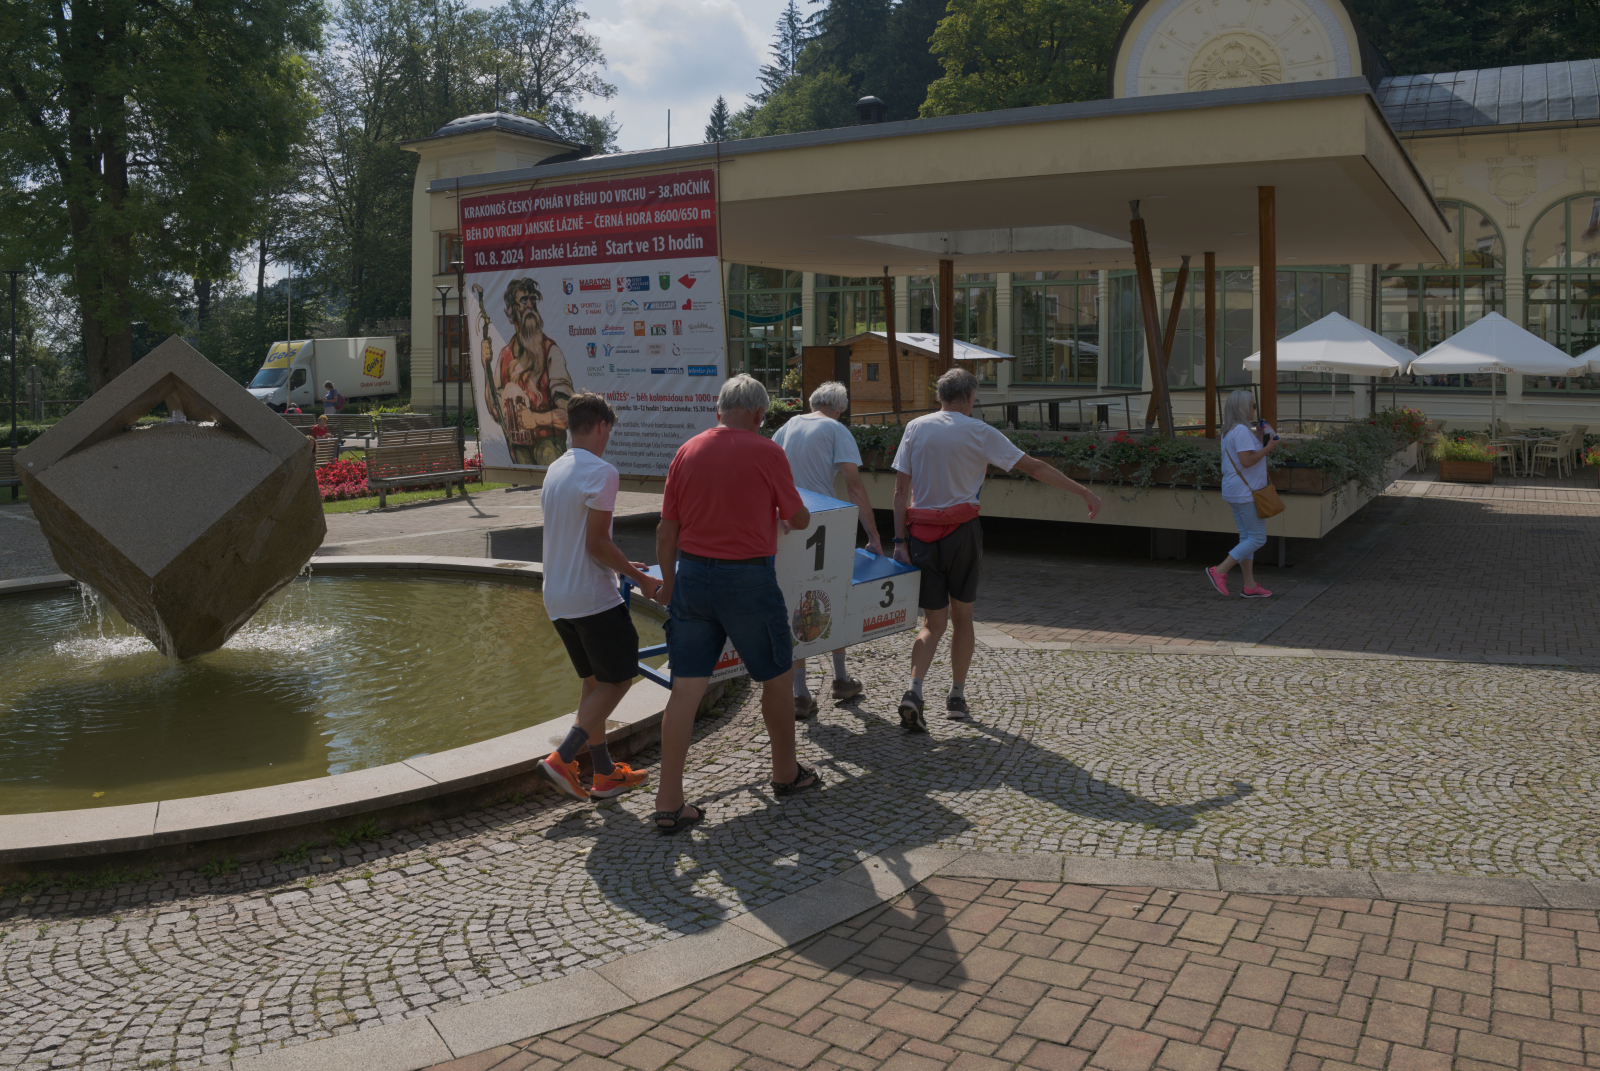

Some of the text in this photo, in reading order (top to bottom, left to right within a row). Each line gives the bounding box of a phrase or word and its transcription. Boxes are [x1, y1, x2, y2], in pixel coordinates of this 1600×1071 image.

[464, 201, 506, 219] KRAKONOŠ
[508, 197, 532, 214] ČESKÝ
[534, 194, 564, 210] POHÁR
[565, 194, 572, 207] V
[574, 190, 598, 206] BĚHU
[600, 191, 612, 204] DO
[614, 186, 646, 202] VRCHU
[658, 185, 672, 198] 38.
[673, 178, 710, 196] ROČNÍK
[466, 226, 482, 241] BĚH
[483, 228, 494, 240] DO
[496, 224, 522, 238] VRCHU
[524, 218, 554, 235] JANSKÉ
[556, 214, 584, 232] LÁZNĚ
[594, 212, 624, 228] ČERNÁ
[626, 211, 652, 226] HORA
[654, 207, 698, 224] 8600/650
[700, 208, 711, 219] m
[474, 233, 704, 266] 10. 8. 2024 Janské Lázně Start ve 13 hodin
[579, 278, 610, 286] MARATON
[268, 348, 298, 363] Geis
[366, 357, 380, 372] Geis
[636, 393, 648, 401] běh
[649, 393, 683, 402] kolonádou
[694, 394, 711, 402] 1000
[806, 524, 826, 572] 1
[879, 580, 895, 608] 3
[863, 608, 906, 626] MARATON
